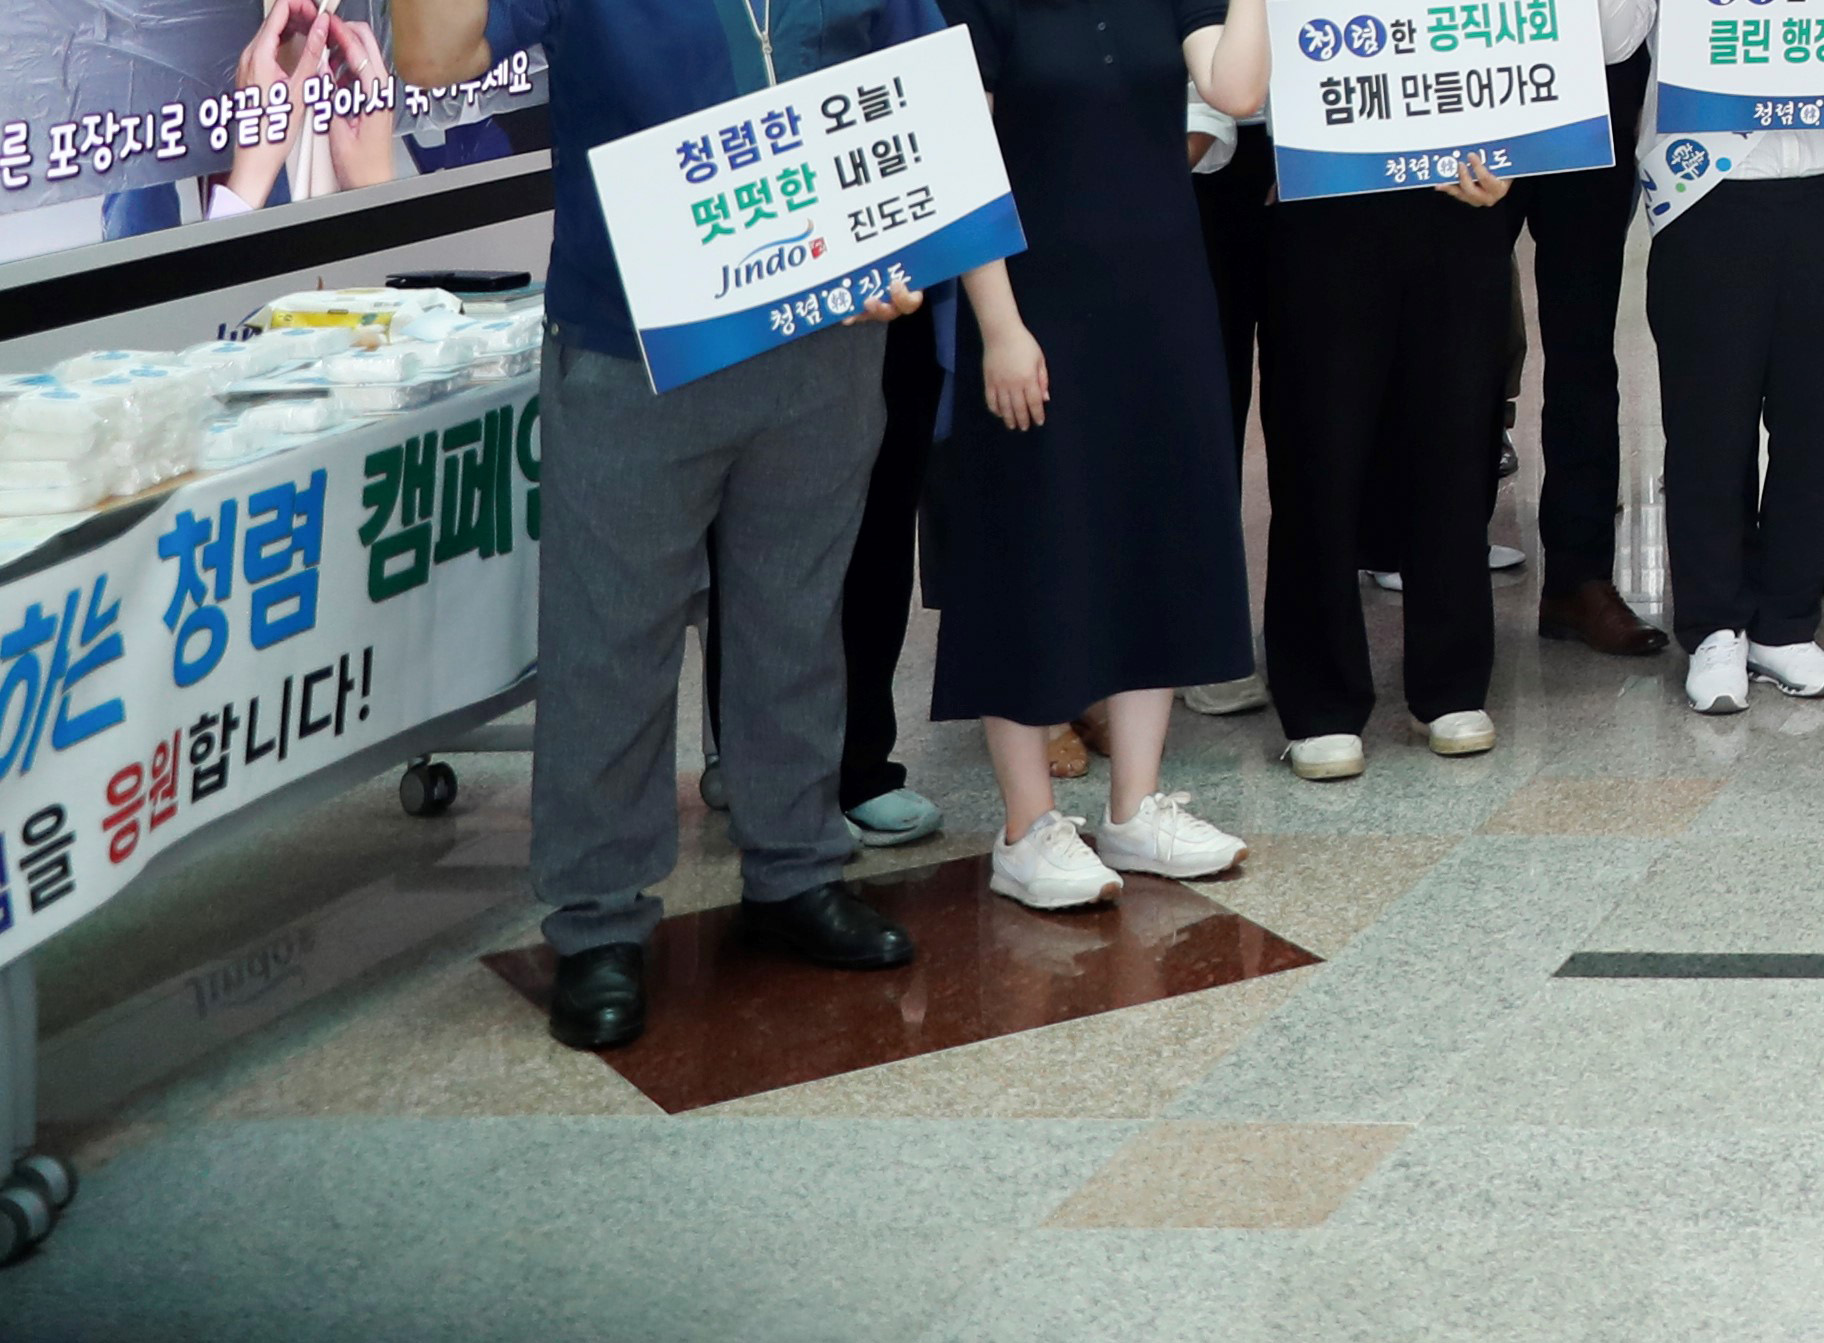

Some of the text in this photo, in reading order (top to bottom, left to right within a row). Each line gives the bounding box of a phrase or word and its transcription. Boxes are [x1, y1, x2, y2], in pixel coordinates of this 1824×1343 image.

[1298, 14, 1416, 62] 청렴한
[1709, 18, 1770, 65] 클린
[46, 102, 187, 179] 포장지로
[200, 81, 292, 151] 양끝을
[303, 72, 395, 135] 말아서
[676, 76, 908, 184] 청렴한 오늘!
[1319, 63, 1558, 126] 함께 만들어가요
[691, 132, 922, 245] 떳떳한 내일!
[714, 185, 936, 299] Jindo 진도군
[158, 468, 327, 689] 청렴
[102, 646, 373, 866] 응원합니다!
